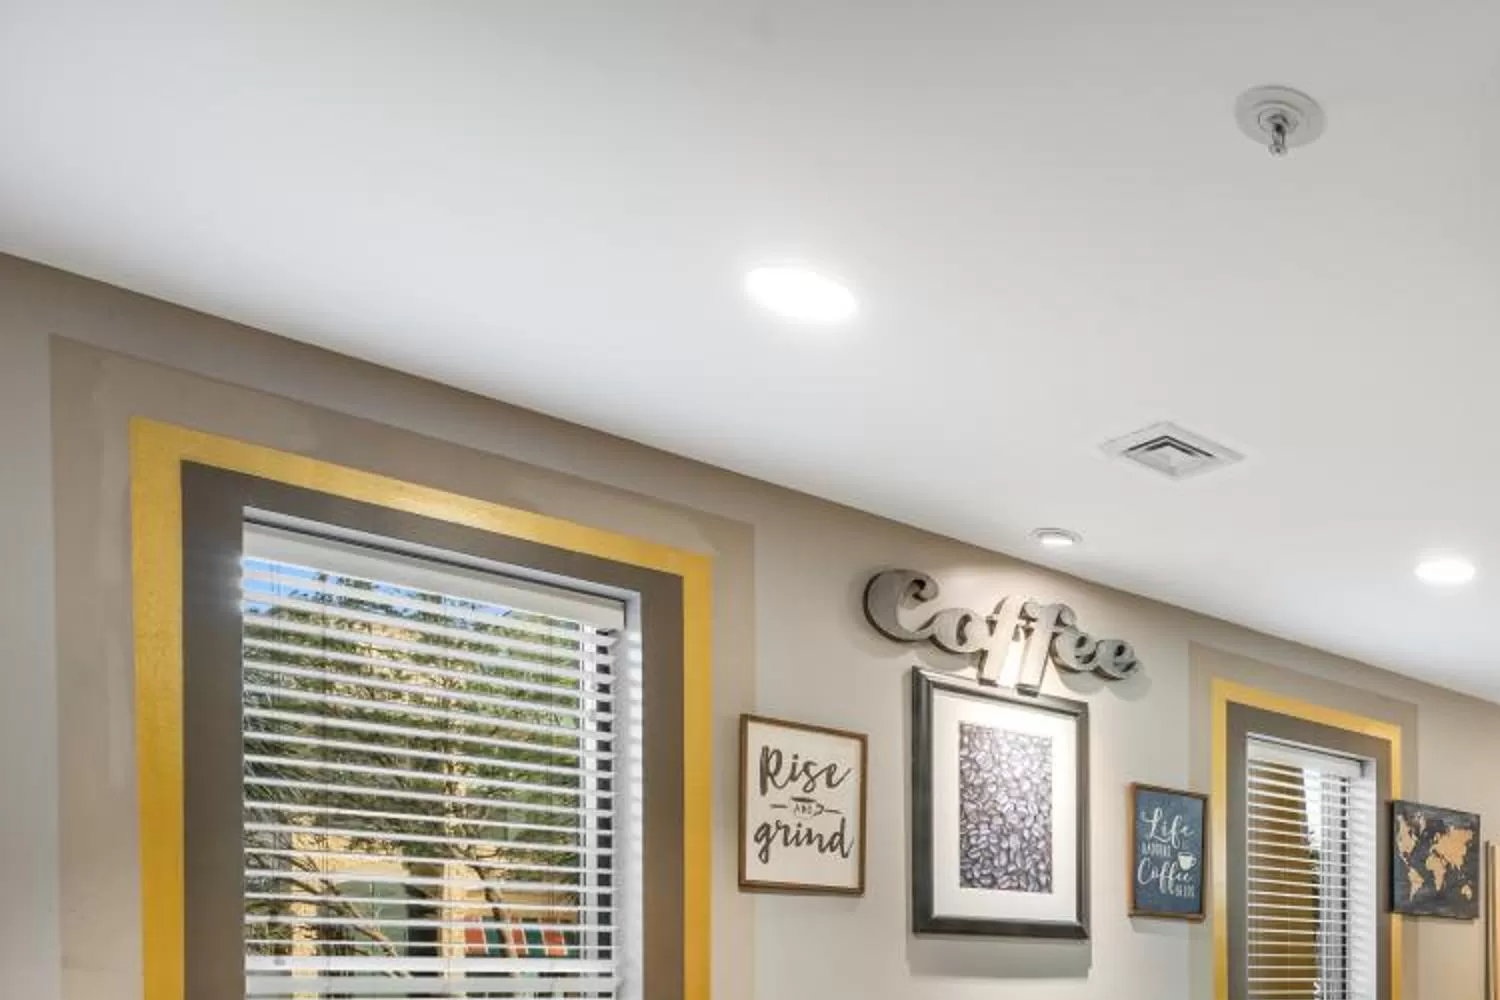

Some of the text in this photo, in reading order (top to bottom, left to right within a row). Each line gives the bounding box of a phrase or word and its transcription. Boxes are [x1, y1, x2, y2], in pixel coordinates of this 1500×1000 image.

[862, 568, 1138, 697] Coffee
[759, 745, 853, 796] Rise
[753, 816, 855, 864] grind
[1141, 807, 1194, 849] Life
[1137, 857, 1193, 895] Coffee
